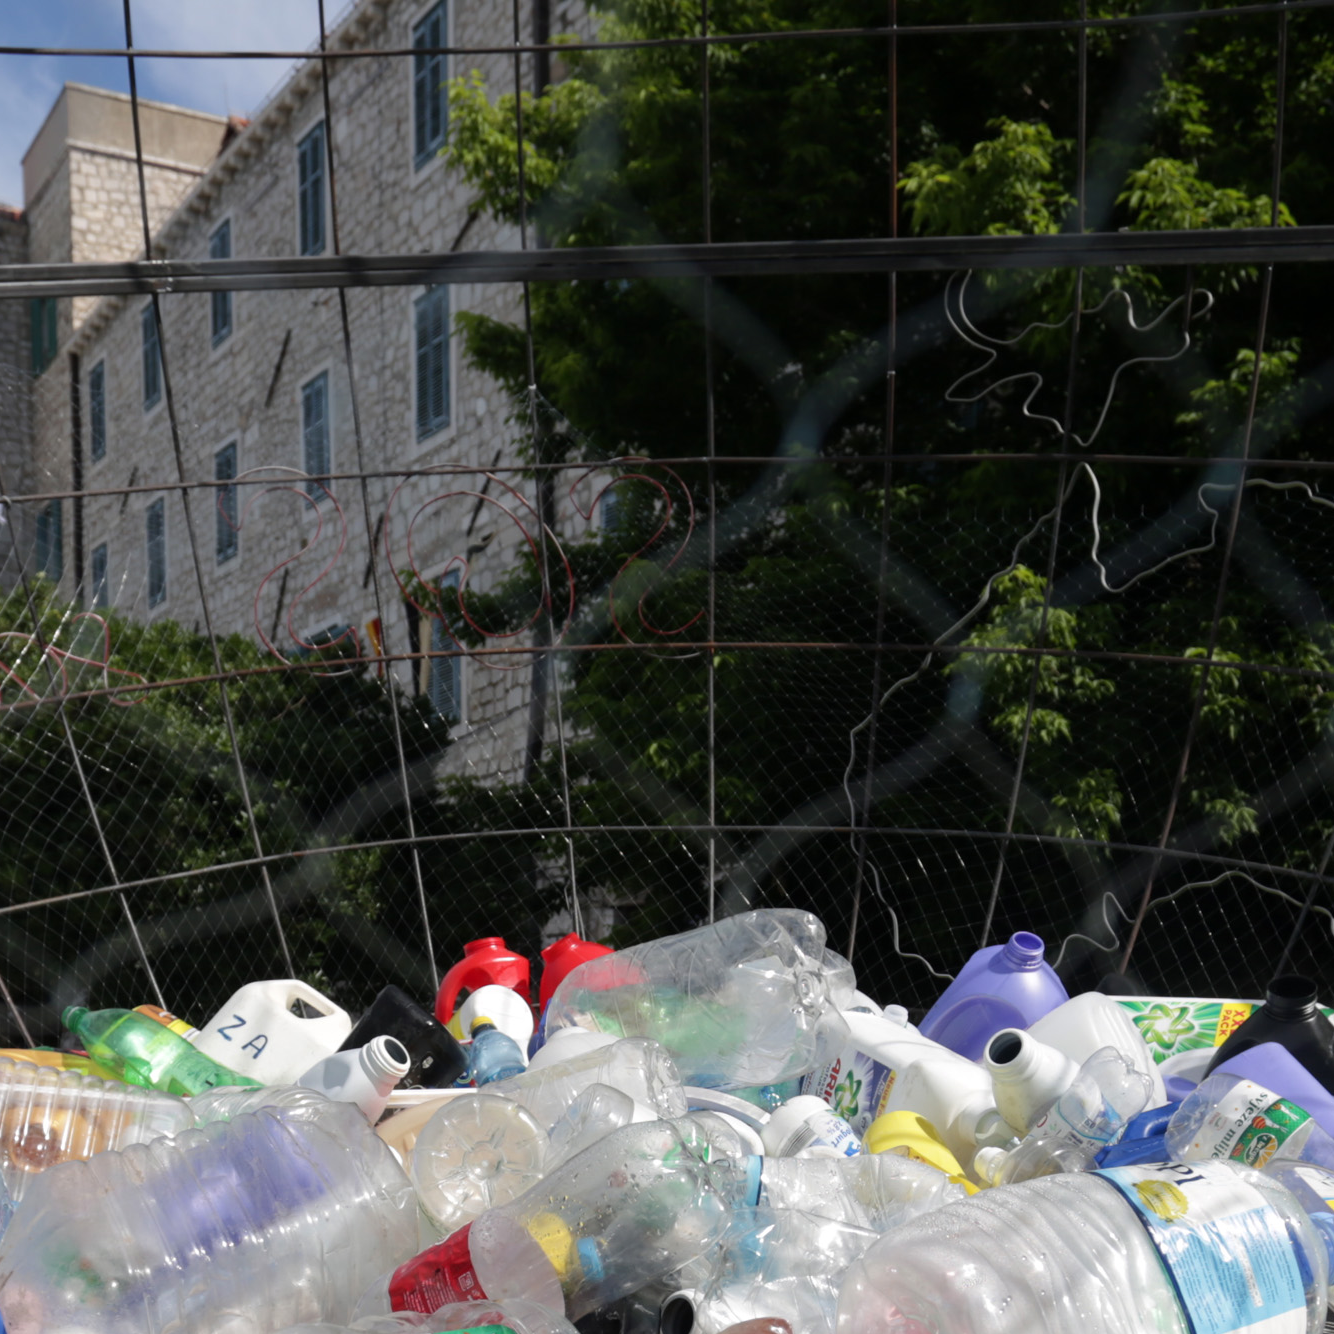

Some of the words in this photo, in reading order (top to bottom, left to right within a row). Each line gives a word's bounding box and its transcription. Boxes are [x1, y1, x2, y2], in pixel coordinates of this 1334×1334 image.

[1218, 1009, 1232, 1037] PACK
[821, 1057, 842, 1104] ARI
[1210, 1127, 1237, 1161] mlije
